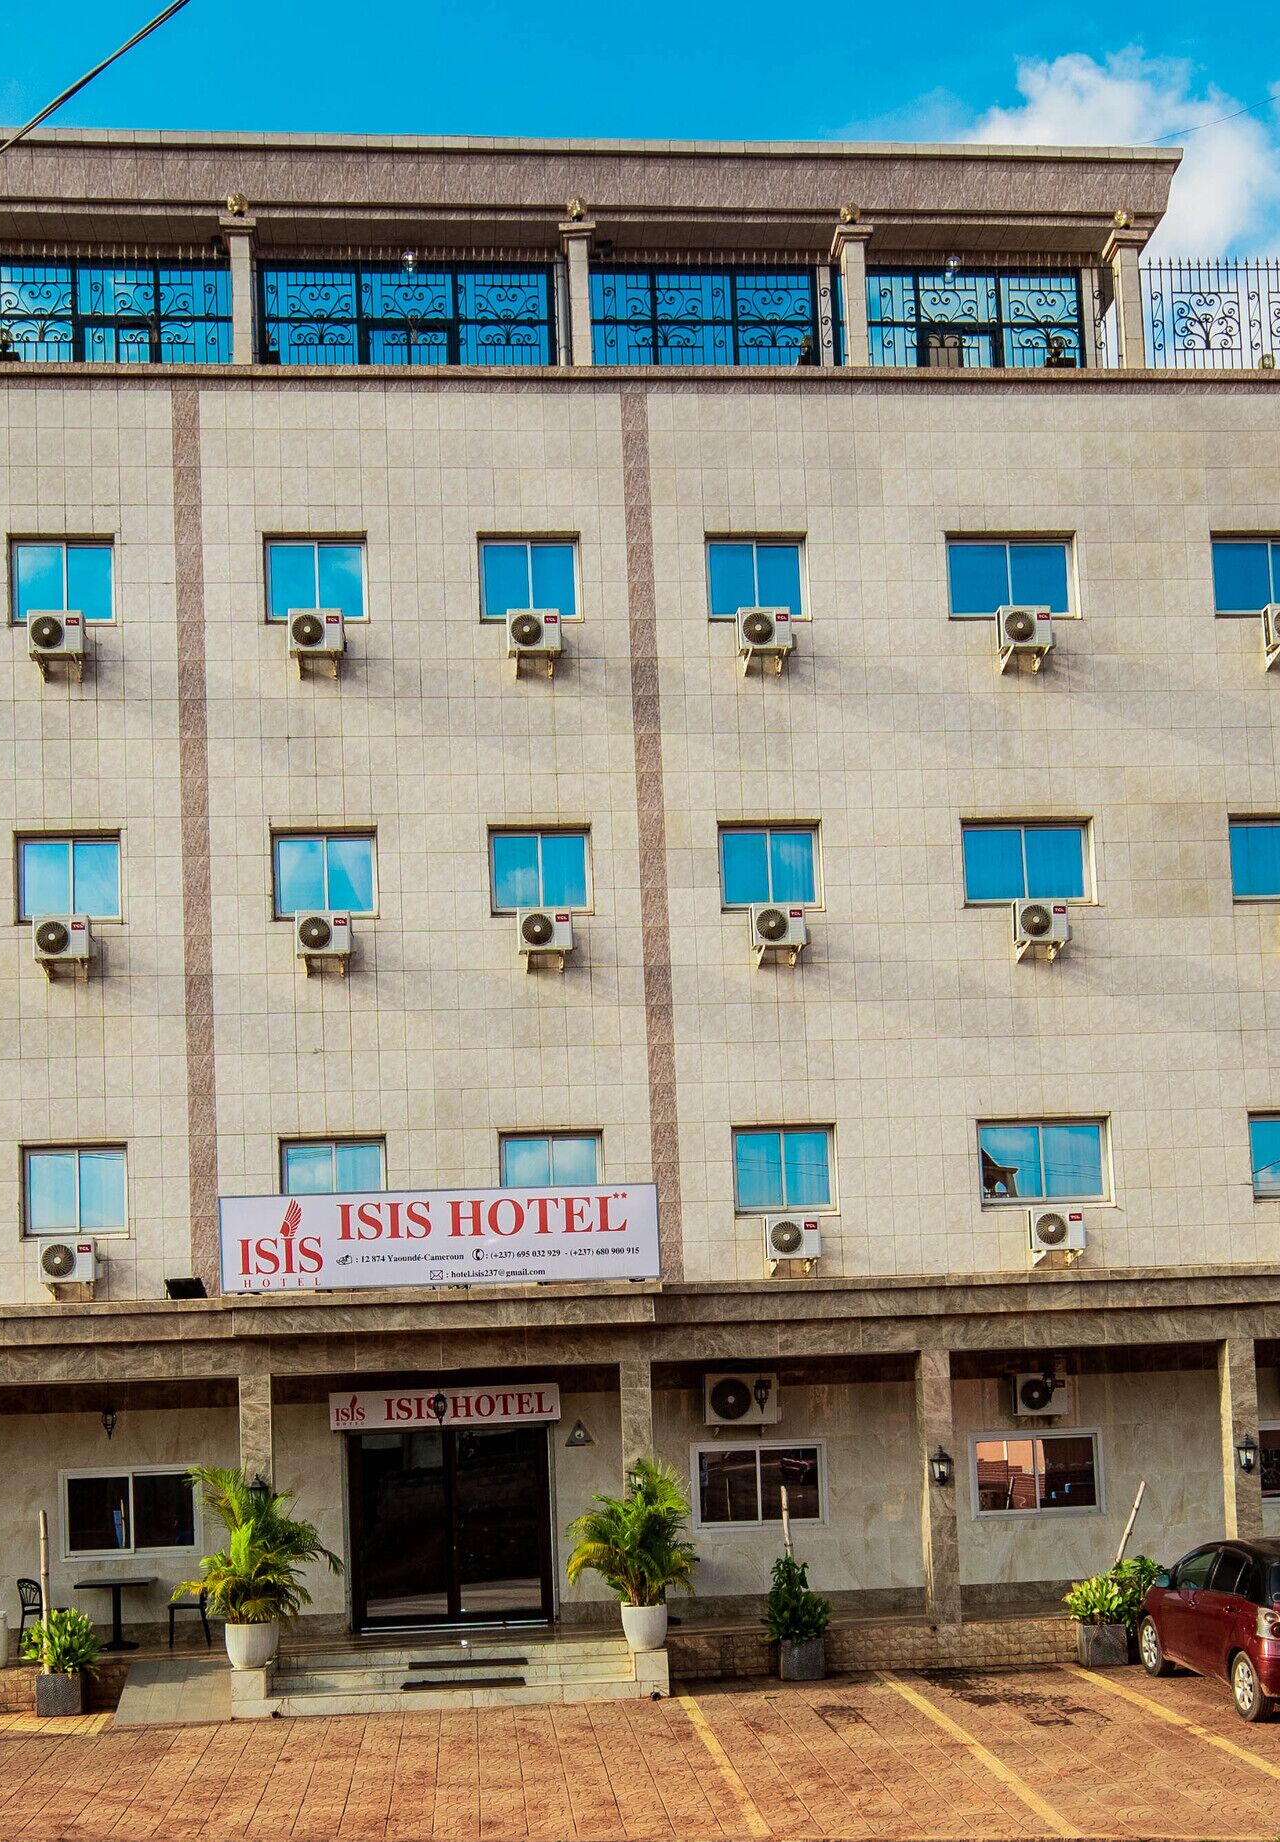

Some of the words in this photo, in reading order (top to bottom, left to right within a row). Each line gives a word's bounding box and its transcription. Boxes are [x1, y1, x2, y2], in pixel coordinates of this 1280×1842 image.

[336, 1201, 432, 1241] ISIS
[446, 1196, 628, 1237] HOTEL
[237, 1236, 324, 1276] ISIS
[360, 1255, 370, 1263] 12
[371, 1255, 385, 1263] 874
[387, 1253, 465, 1263] Yaoundé-Cameroun
[490, 1250, 515, 1260] (+237)
[516, 1250, 530, 1258] 695
[547, 1249, 561, 1257] 929
[569, 1248, 594, 1257] (+237)
[595, 1247, 610, 1255] 680
[611, 1247, 625, 1255] 900
[626, 1246, 640, 1254] 915
[450, 1268, 546, 1278] hotel.isis237@gmail.com
[243, 1277, 321, 1288] HOTEL
[449, 1391, 554, 1419] HOTEL
[335, 1406, 366, 1422] ISIS
